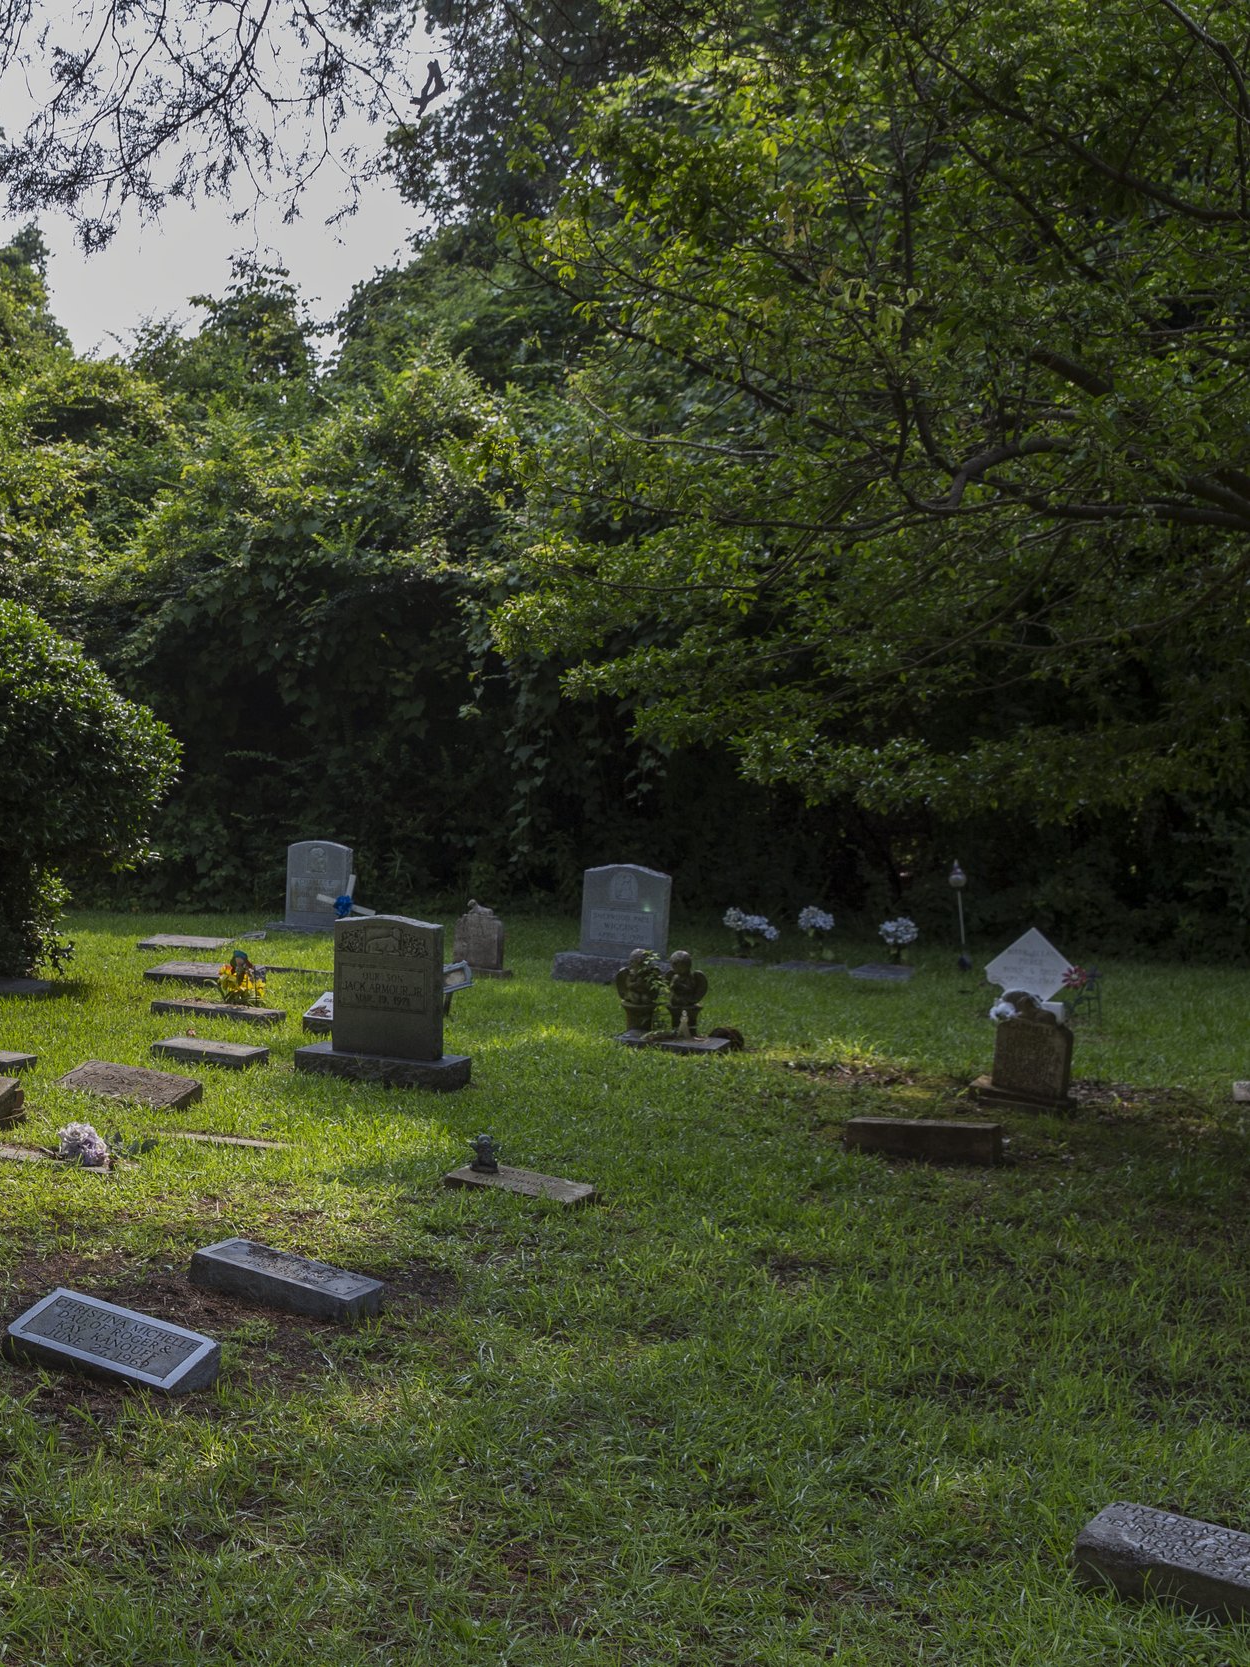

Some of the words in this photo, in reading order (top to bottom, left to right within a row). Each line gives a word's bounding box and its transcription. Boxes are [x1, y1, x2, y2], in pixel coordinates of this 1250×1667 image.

[342, 980, 366, 992] JACK
[44, 1328, 84, 1346] JUNE
[54, 1298, 127, 1329] CHRISTINA
[132, 1323, 200, 1352] MICHELLE
[54, 1320, 81, 1335] KAY
[90, 1333, 161, 1362] KANOUFF
[90, 1320, 109, 1332] OF
[110, 1326, 159, 1350] ROGER
[159, 1345, 174, 1356] &
[1097, 1514, 1166, 1539] DENNIS
[1176, 1538, 1240, 1560] ALLEN
[1112, 1502, 1192, 1528] PHYLLIS
[1200, 1525, 1248, 1544] MAE
[1140, 1536, 1202, 1558] BORN
